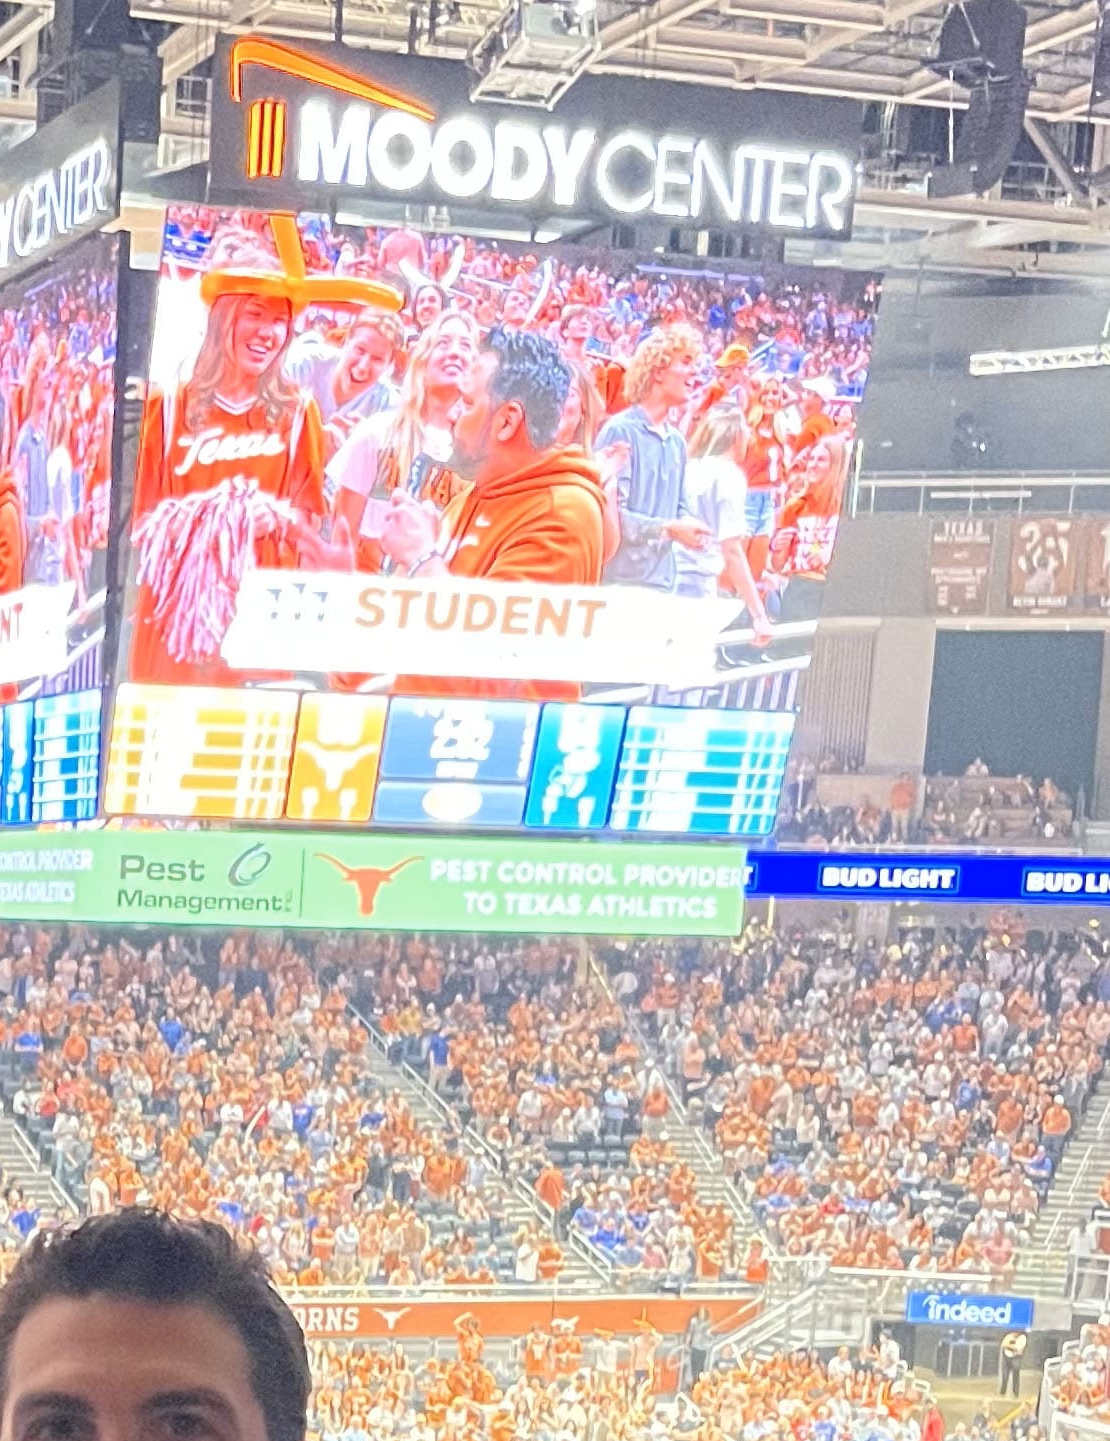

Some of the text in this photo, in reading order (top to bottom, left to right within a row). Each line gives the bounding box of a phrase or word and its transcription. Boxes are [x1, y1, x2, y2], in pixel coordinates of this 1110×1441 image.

[297, 98, 853, 231] MOODY CENTER
[13, 137, 110, 257] CENTER
[174, 425, 286, 477] Texas
[355, 587, 607, 638] STUDENT
[120, 854, 205, 882] Pest
[430, 858, 493, 882] PEST
[497, 861, 617, 886] CONTROL
[623, 863, 745, 889] PROVIDER
[822, 866, 955, 890] BUD LIGHT
[1025, 871, 1110, 894] BUD LI
[117, 889, 283, 915] Management
[463, 891, 718, 920] TO TEXAS ATHLETICS
[922, 1294, 1012, 1324] indeed
